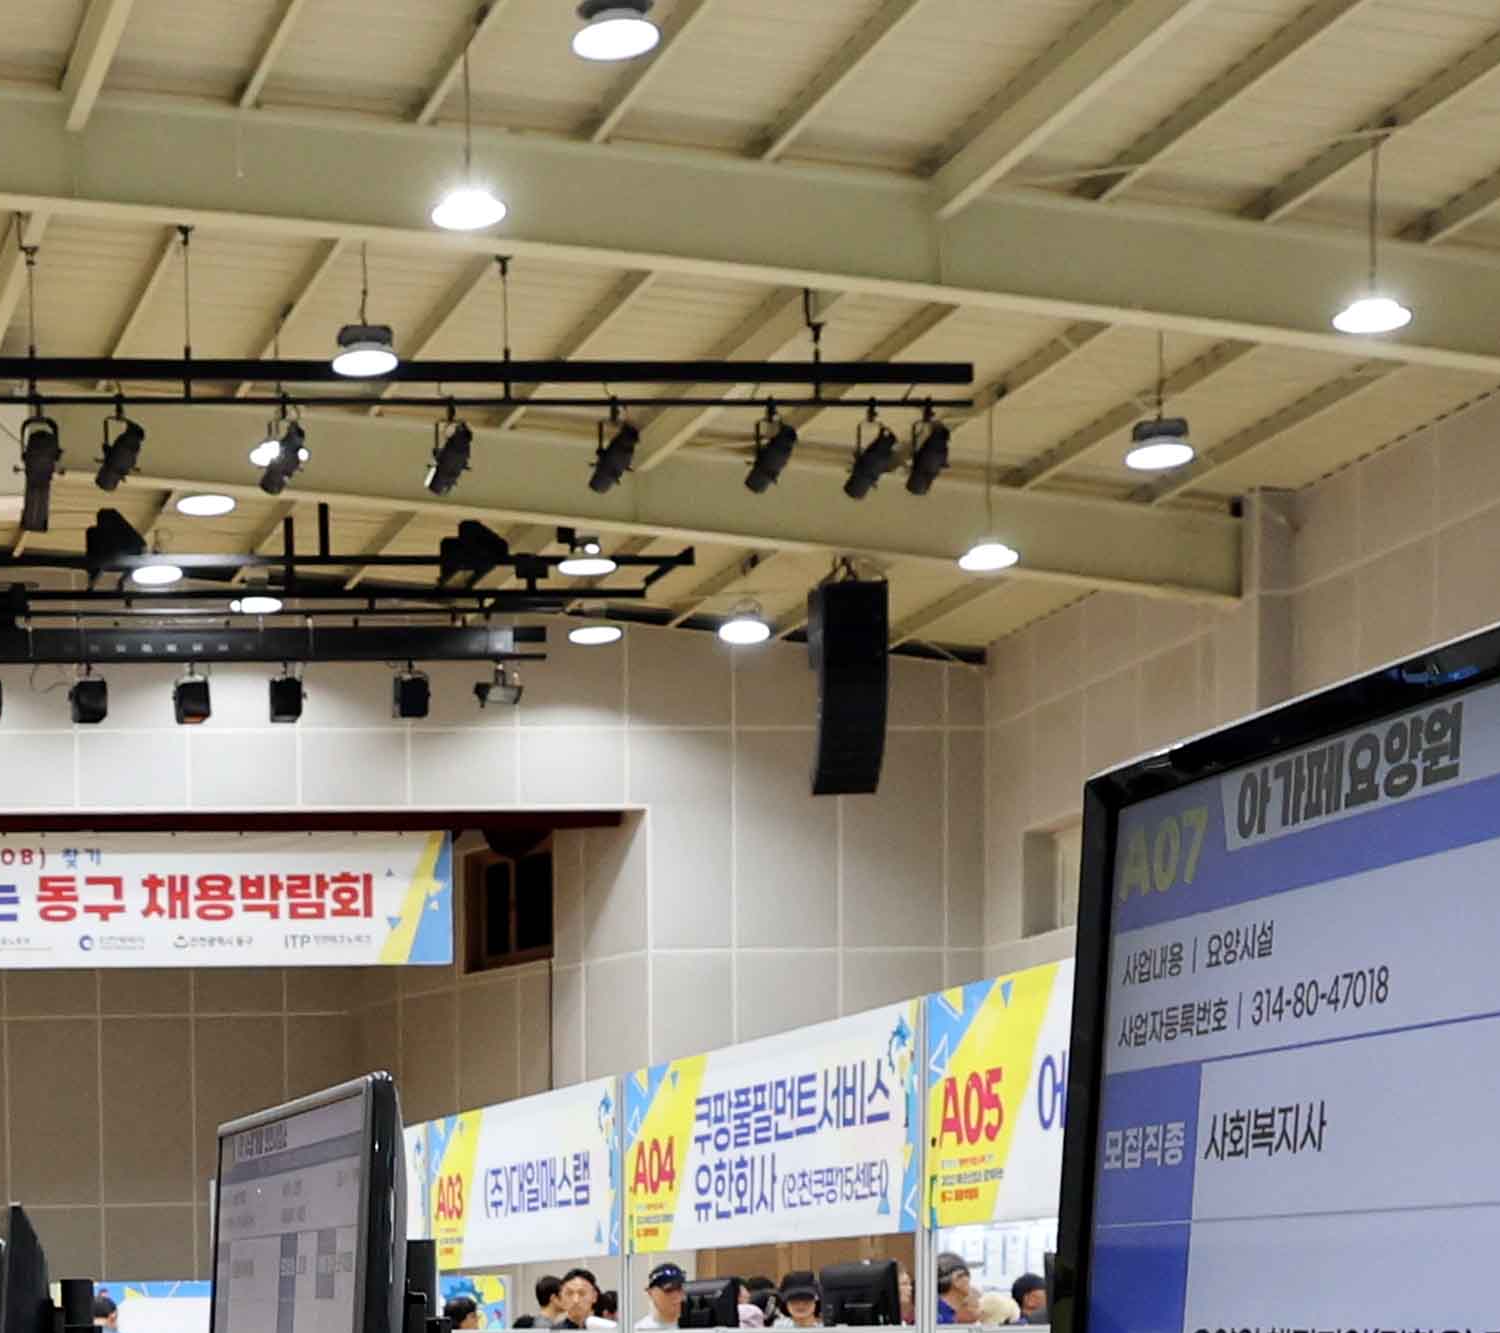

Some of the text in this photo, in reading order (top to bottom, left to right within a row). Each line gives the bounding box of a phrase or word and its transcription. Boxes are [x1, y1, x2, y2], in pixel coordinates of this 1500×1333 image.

[1237, 702, 1464, 839] 아가페요양원
[1119, 805, 1209, 899] A07
[36, 873, 127, 922] 동구
[140, 872, 373, 920] 채용박람회
[1121, 920, 1275, 986] 사업내용 요양시설
[1117, 965, 1390, 1049] 사업자등록번호 314-80-47018
[694, 1058, 891, 1154] 쿠팡풀필먼트서비스
[939, 1066, 1004, 1149] A05
[1103, 1100, 1328, 1170] 모집직종 사회복지사
[435, 1171, 464, 1222] A03
[633, 1135, 676, 1196] A04
[694, 1151, 778, 1222] 유한회사
